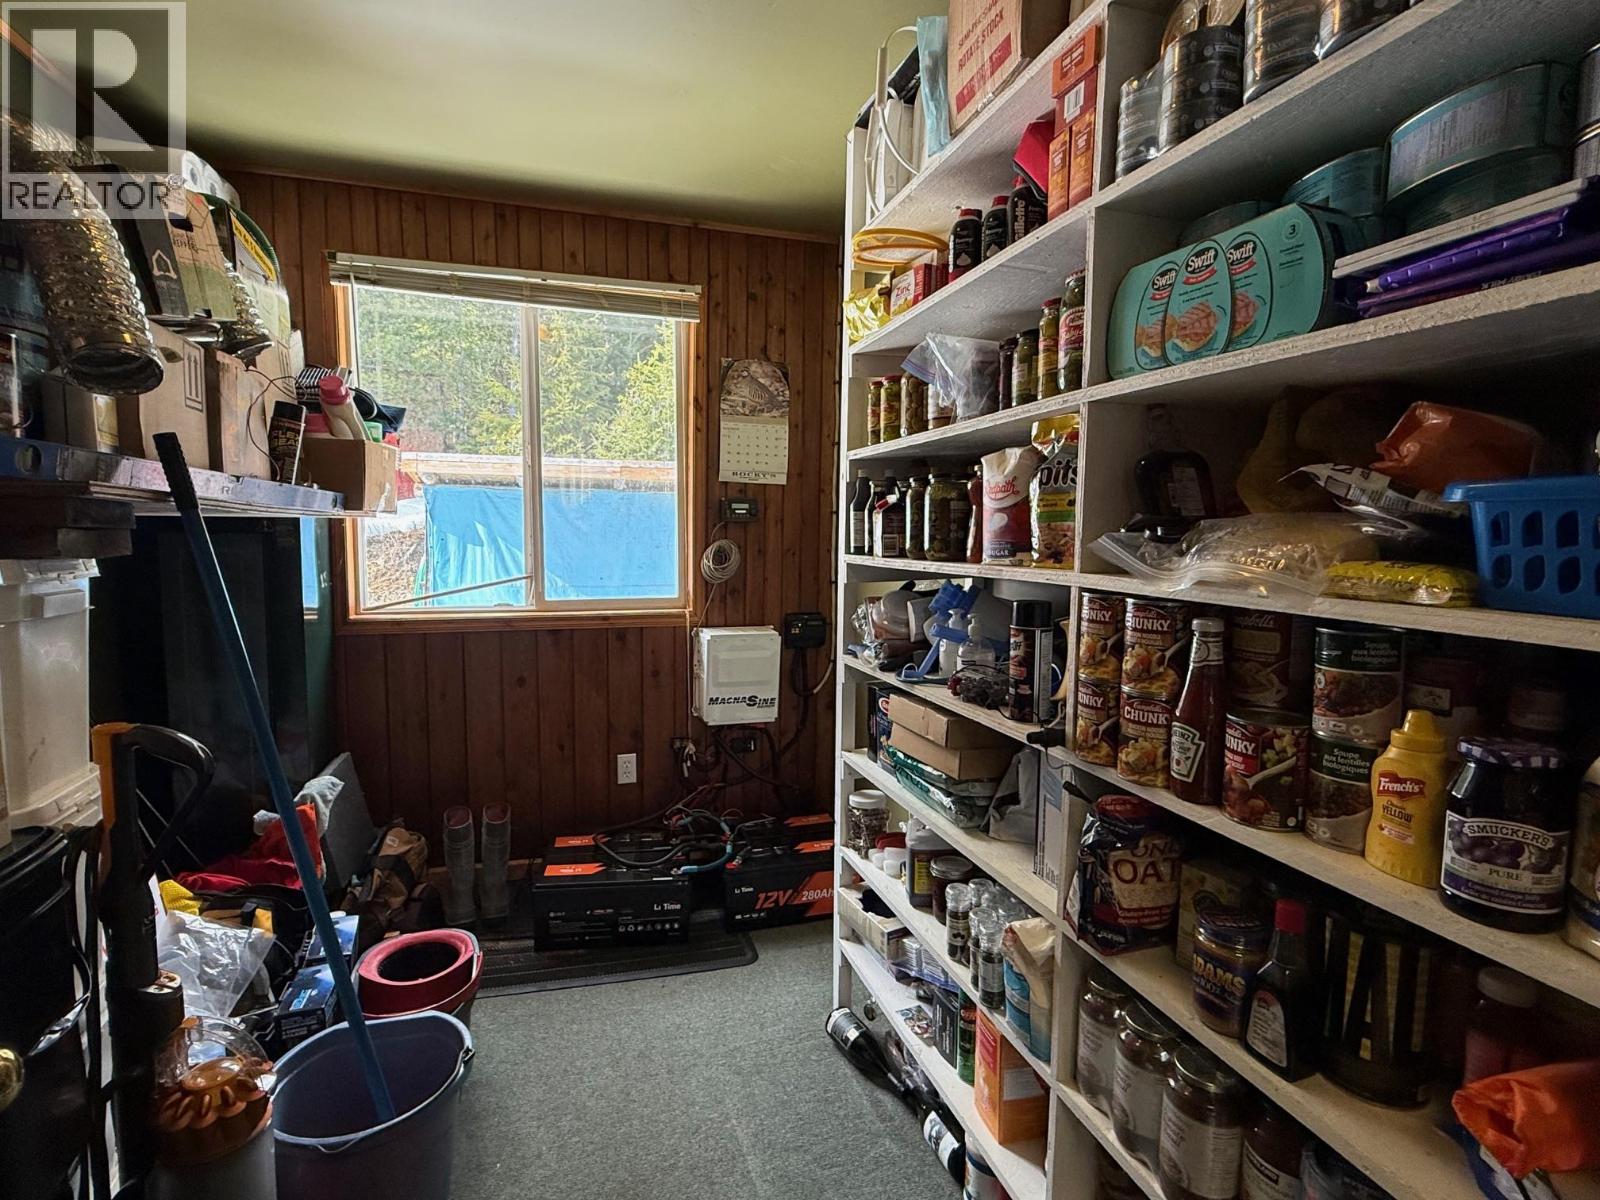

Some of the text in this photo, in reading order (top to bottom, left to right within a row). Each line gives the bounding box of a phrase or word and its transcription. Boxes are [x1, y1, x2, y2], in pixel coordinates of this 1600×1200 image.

[982, 7, 1004, 45] STOCK
[1188, 247, 1217, 272] Swift
[1227, 243, 1255, 264] Swift
[990, 548, 1009, 557] UGAR
[1124, 705, 1170, 725] CHUNK
[1226, 732, 1257, 755] UNKY
[1332, 747, 1361, 760] Soupe
[1322, 760, 1370, 776] biologiques
[1379, 776, 1421, 794] French's
[1382, 804, 1413, 824] YELLOW
[1467, 824, 1551, 848] SMUCKER'S
[1488, 868, 1523, 881] PURE
[754, 888, 794, 911] 12V
